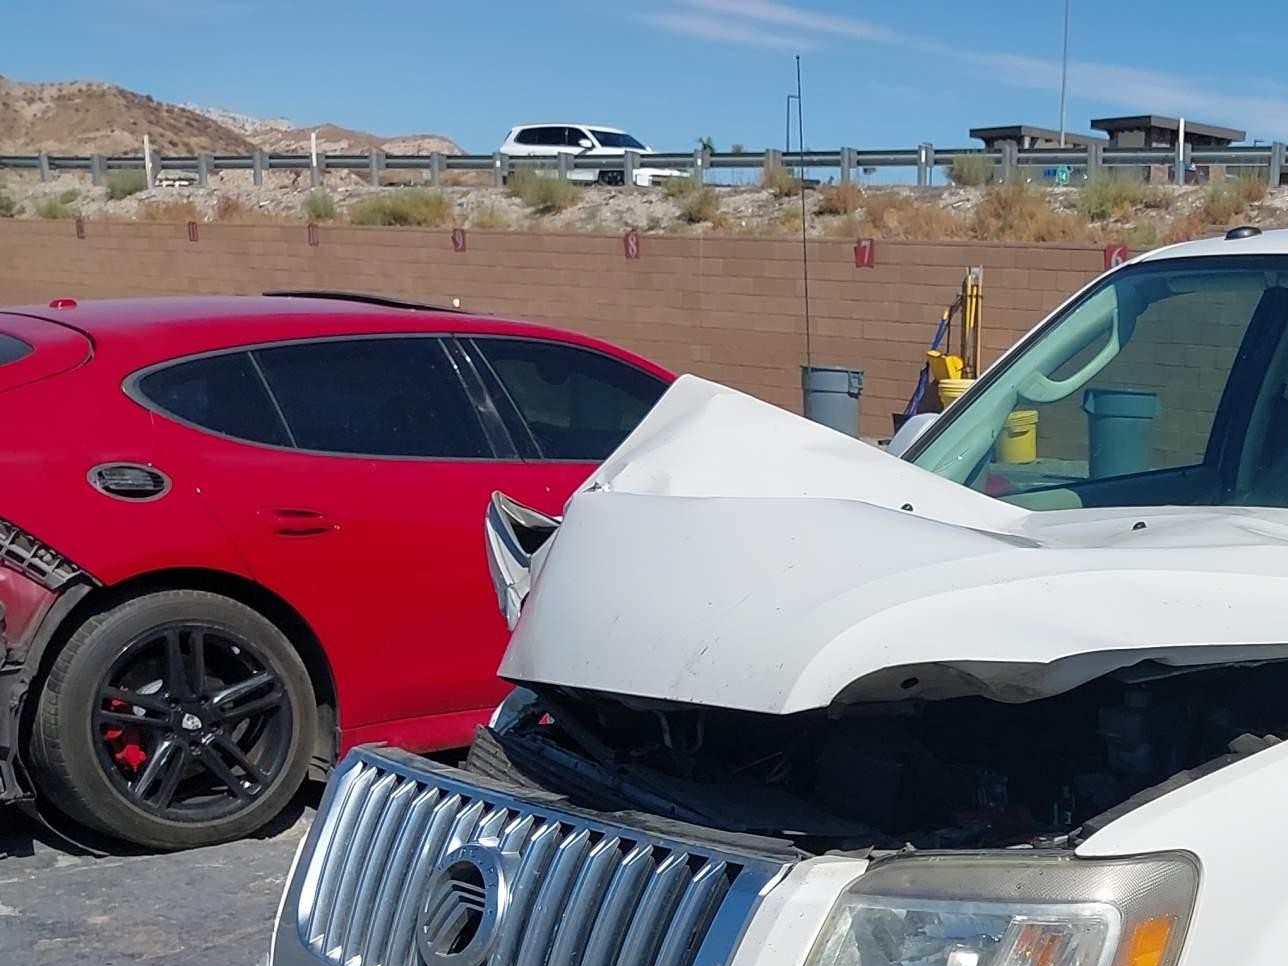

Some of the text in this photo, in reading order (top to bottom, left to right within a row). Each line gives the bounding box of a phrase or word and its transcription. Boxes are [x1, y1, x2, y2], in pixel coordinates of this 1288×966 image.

[455, 229, 463, 249] 9
[628, 232, 637, 257] 8
[860, 240, 871, 264] 7
[1111, 247, 1124, 267] 6
